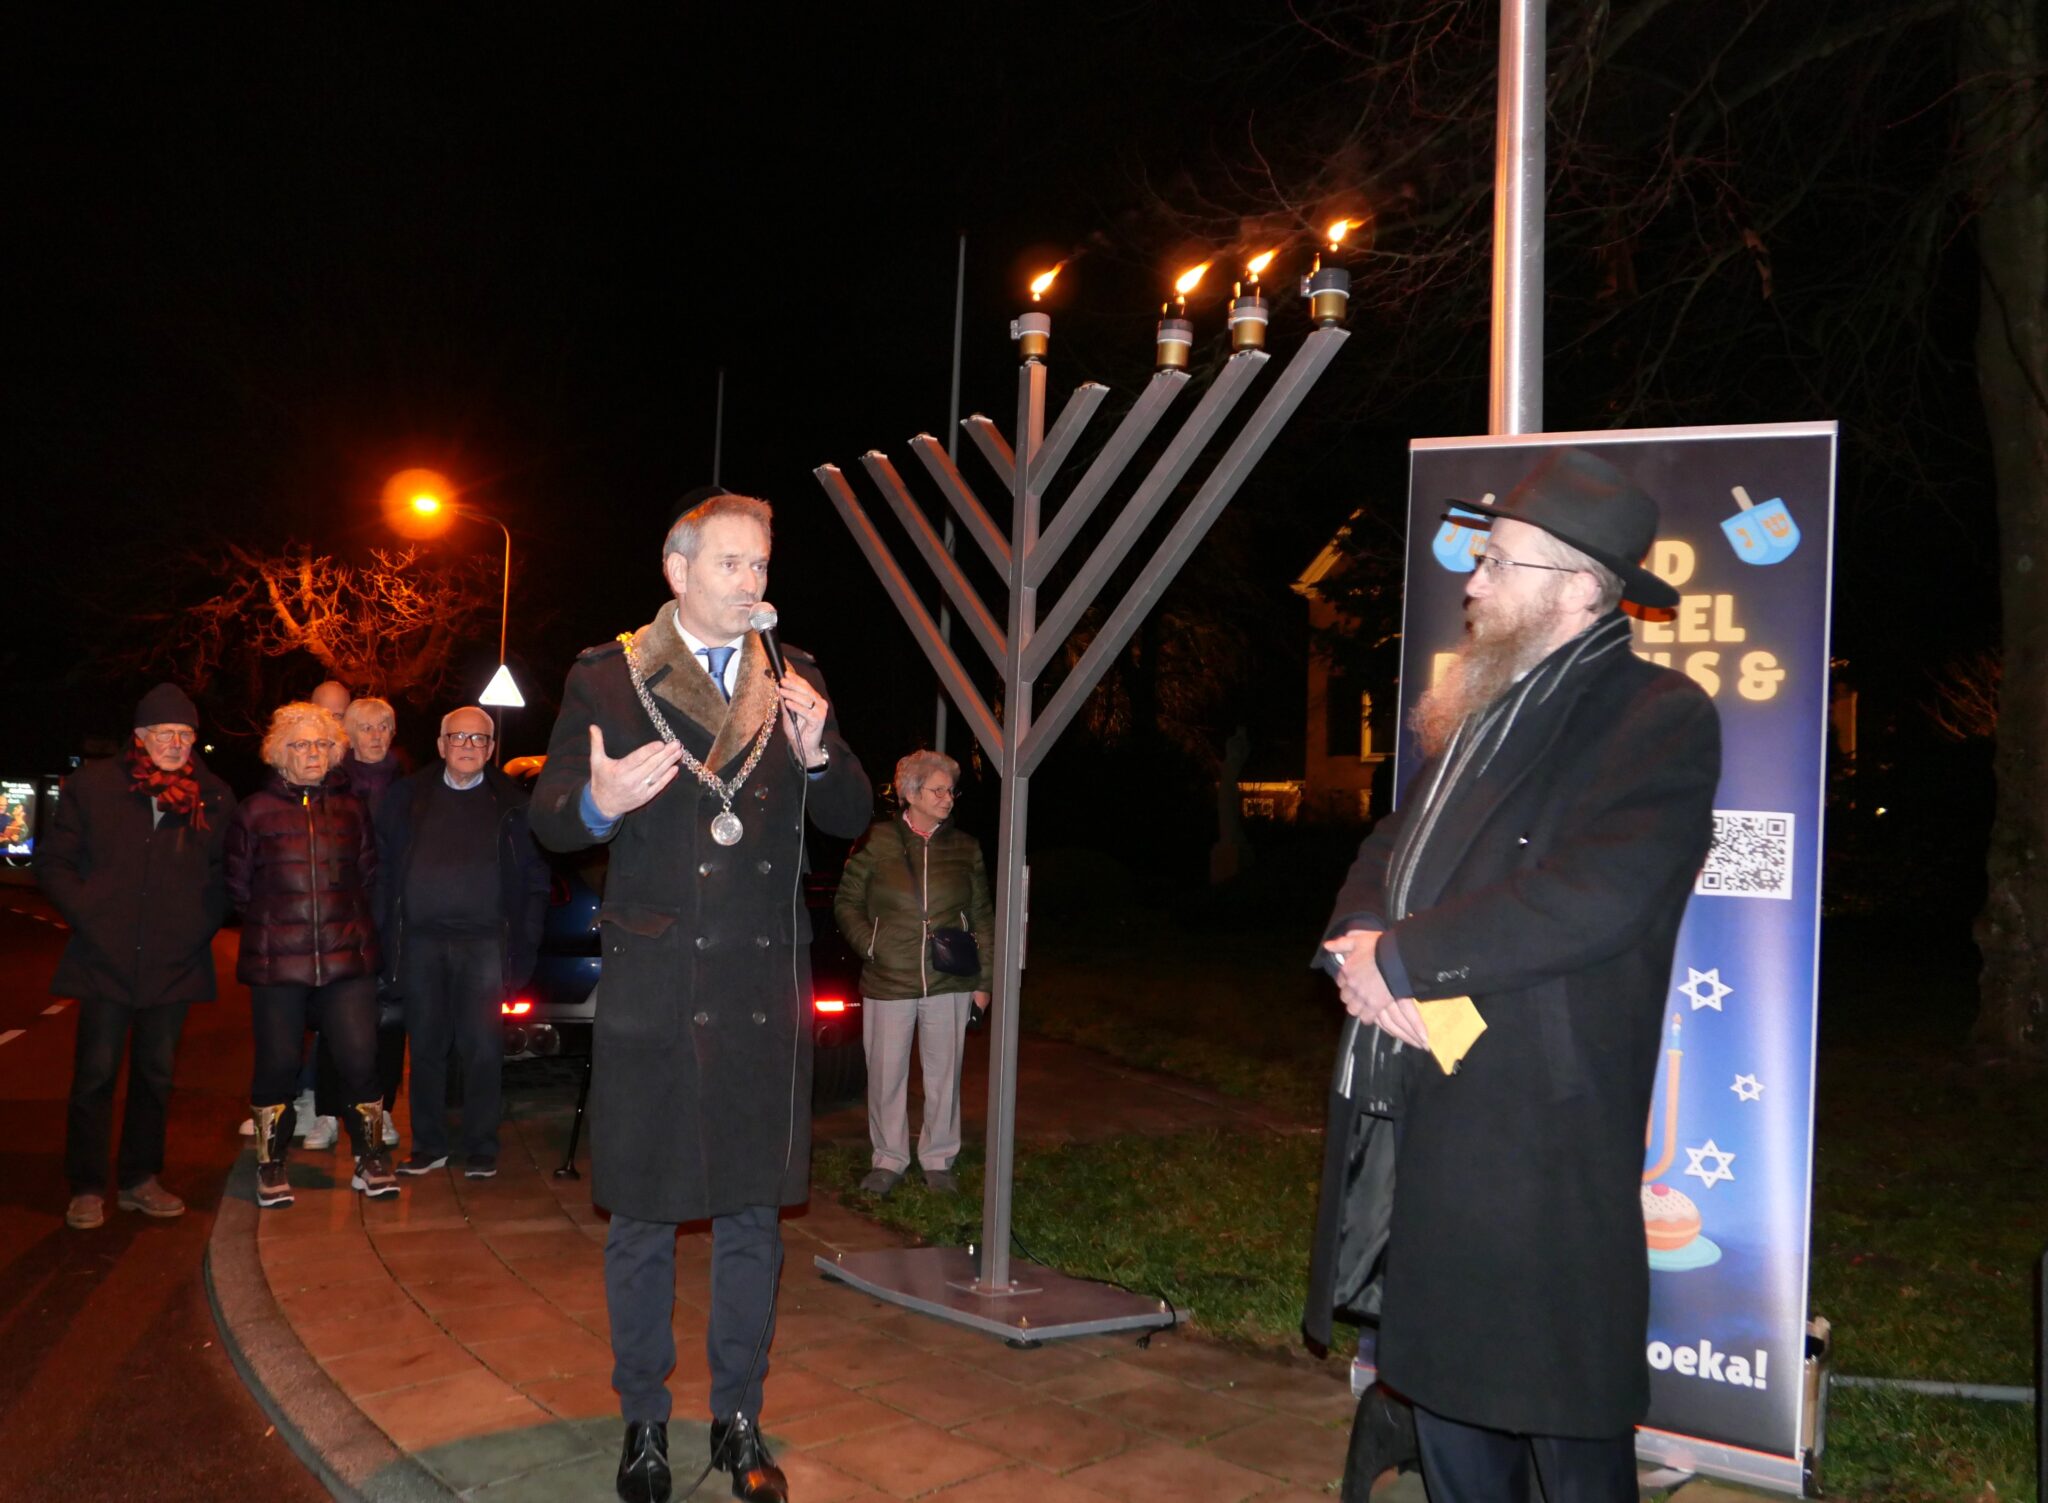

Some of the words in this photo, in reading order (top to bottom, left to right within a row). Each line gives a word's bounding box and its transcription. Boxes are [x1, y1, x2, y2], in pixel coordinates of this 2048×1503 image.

[1645, 540, 1695, 587] D
[1630, 594, 1746, 643] EEL
[1737, 651, 1786, 701] &
[1646, 1339, 1768, 1390] oeka!
